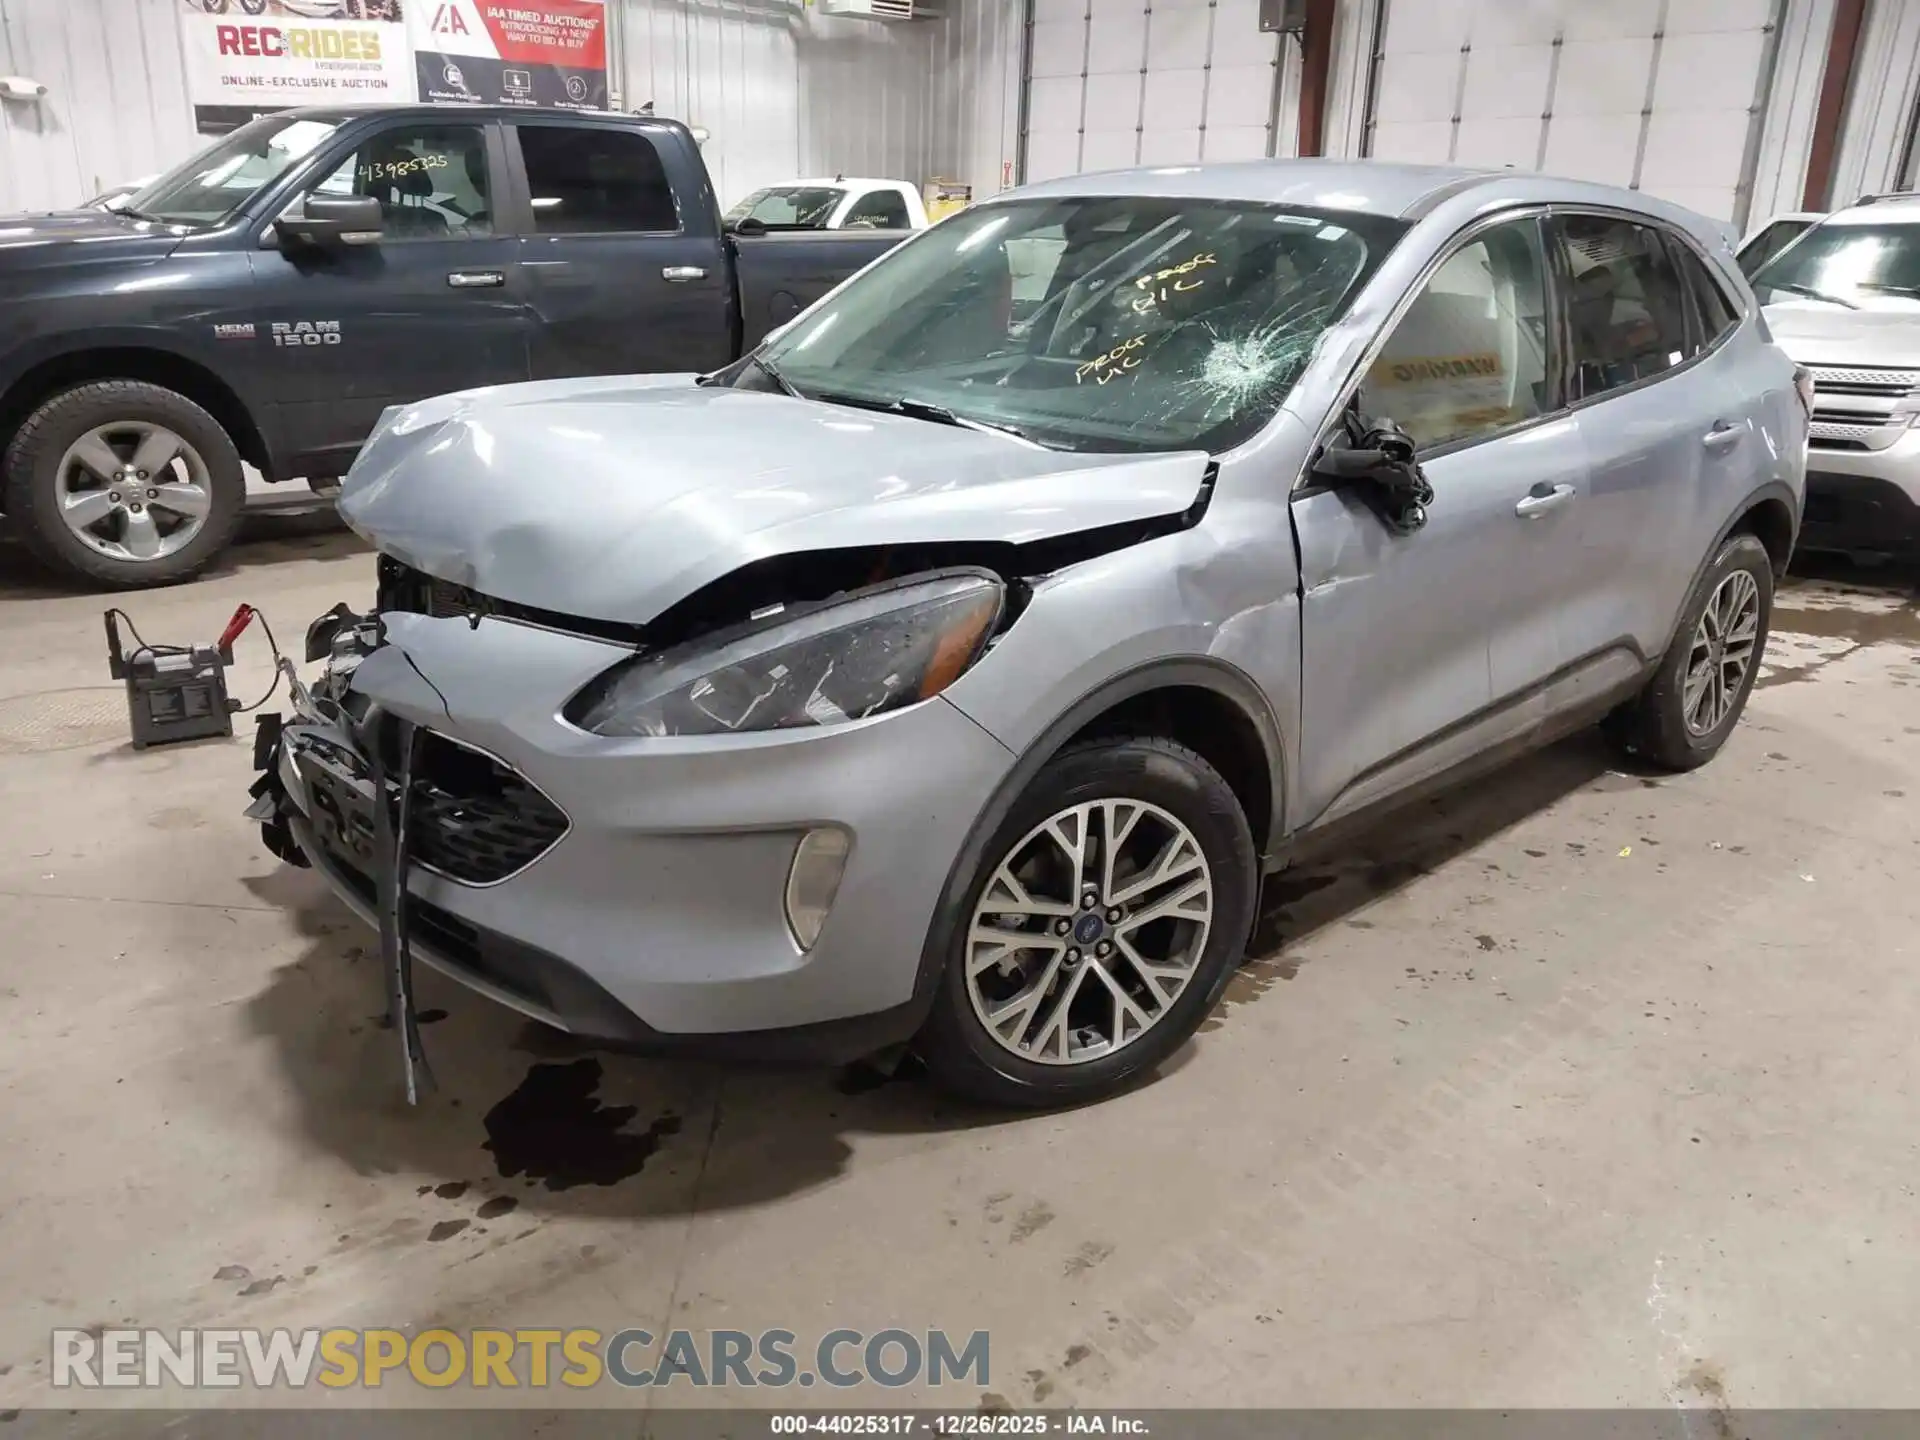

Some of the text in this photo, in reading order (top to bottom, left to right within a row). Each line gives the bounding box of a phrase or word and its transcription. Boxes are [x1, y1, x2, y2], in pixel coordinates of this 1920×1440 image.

[507, 9, 541, 22] TIMED
[501, 21, 561, 36] INTRODUCING
[570, 28, 590, 40] NEW
[216, 25, 283, 57] REC
[289, 28, 381, 60] RIDES
[507, 32, 526, 42] WAY
[528, 34, 541, 44] TO
[567, 39, 585, 48] BUY
[221, 75, 388, 89] ONLINE-EXCLUSIVE AUCTION
[358, 155, 448, 182] 43985325
[213, 324, 255, 333] HEMI
[271, 321, 340, 333] RAM
[272, 333, 341, 346] 1500
